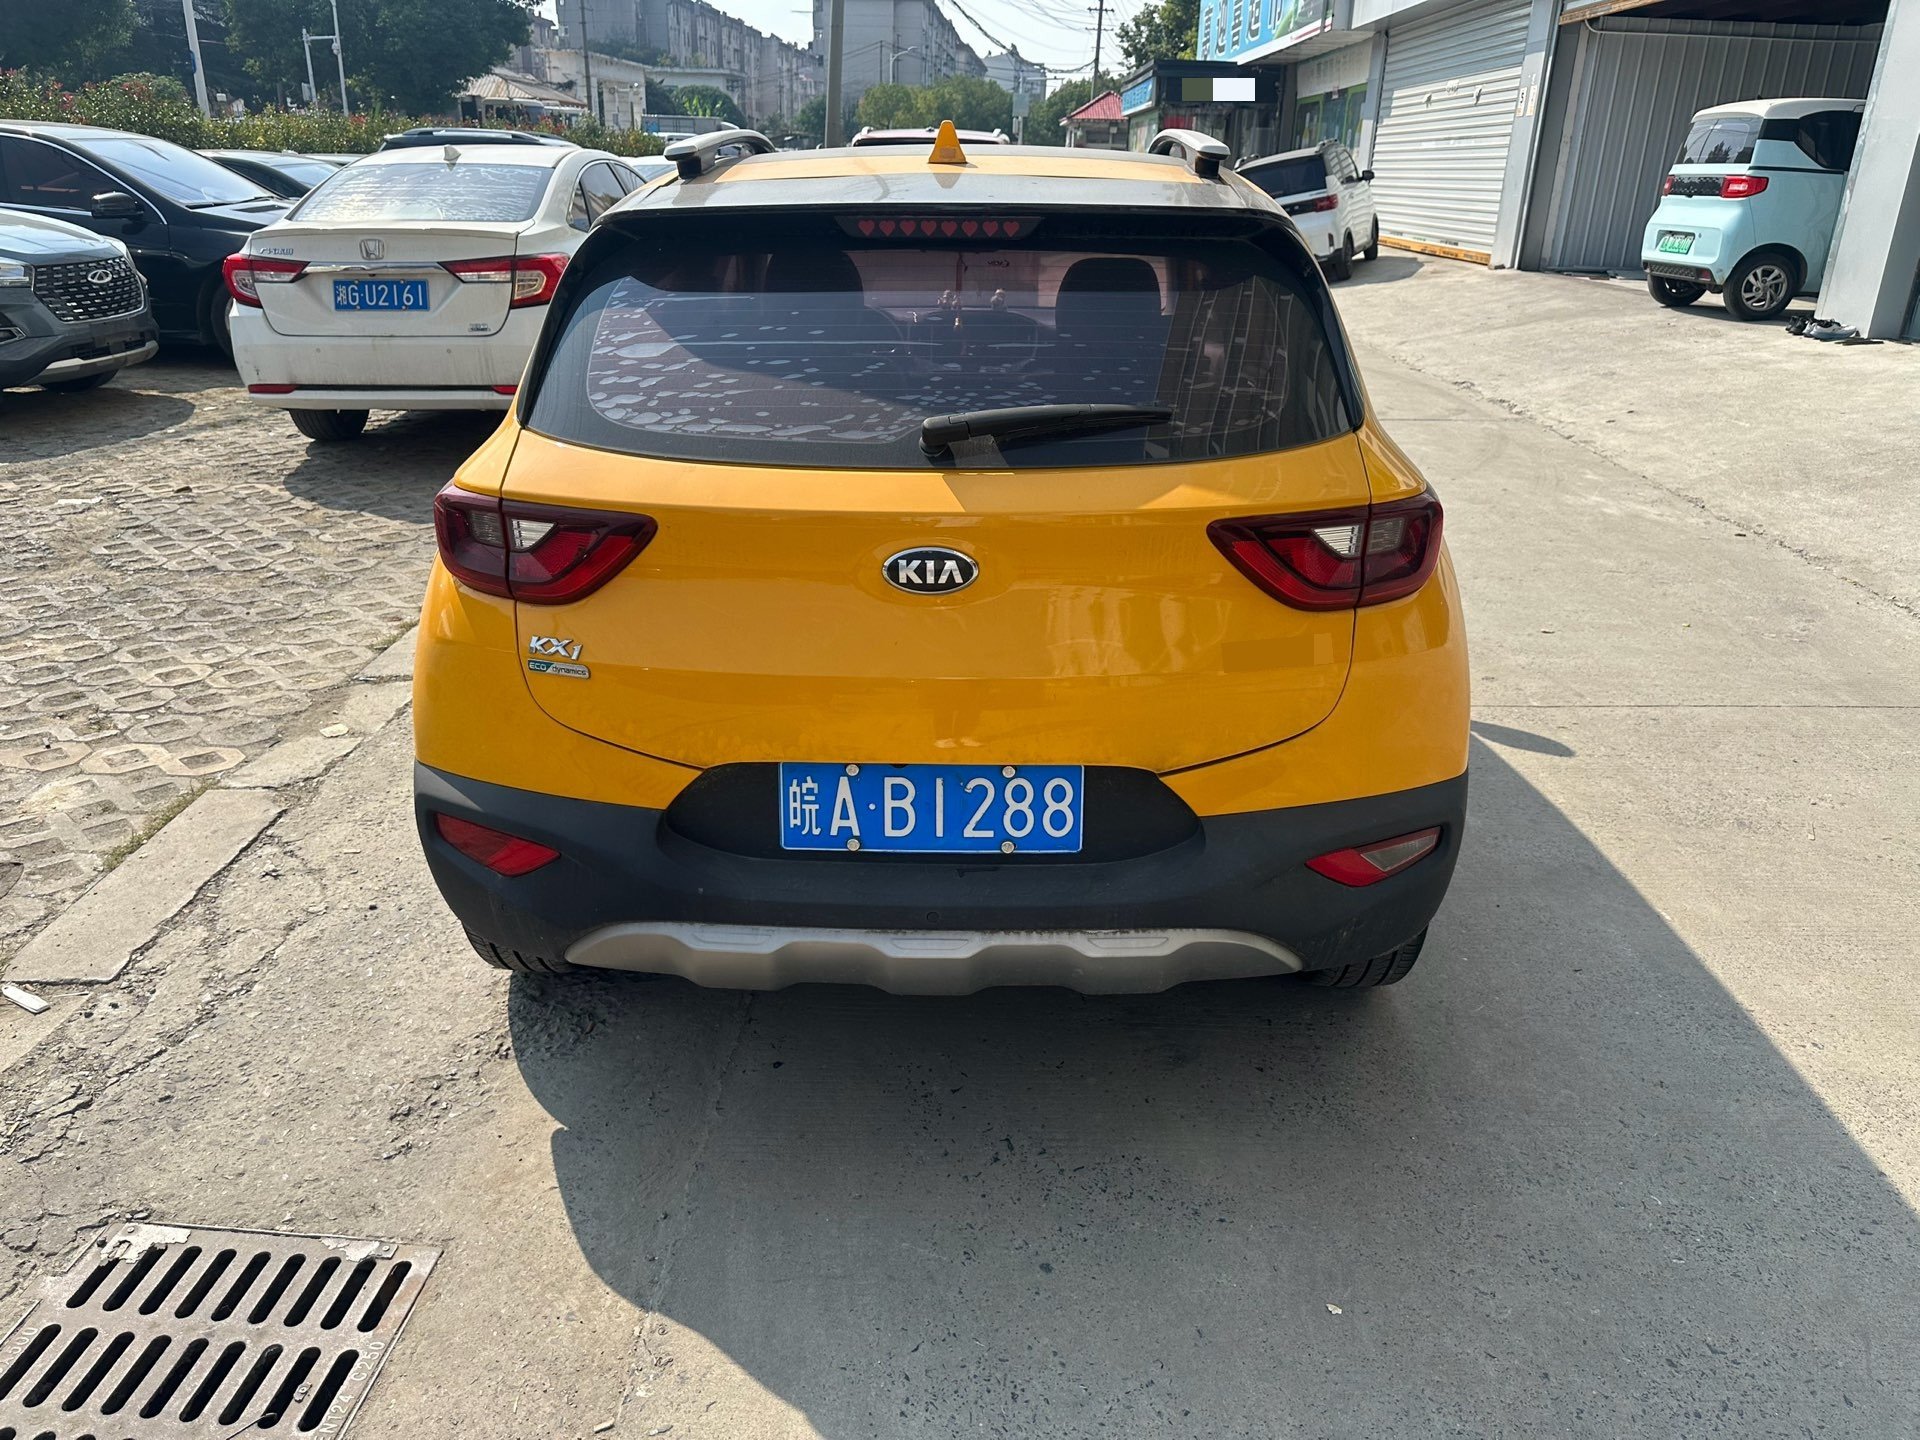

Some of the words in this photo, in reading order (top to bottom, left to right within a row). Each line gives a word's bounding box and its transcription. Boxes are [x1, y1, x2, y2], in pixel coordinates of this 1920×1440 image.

[897, 559, 963, 584] KIA
[529, 635, 583, 660] KX1
[529, 662, 547, 671] ECO
[551, 665, 587, 677] dynamics
[788, 775, 1075, 838] 皖A·B1288
[351, 1341, 386, 1381] C250
